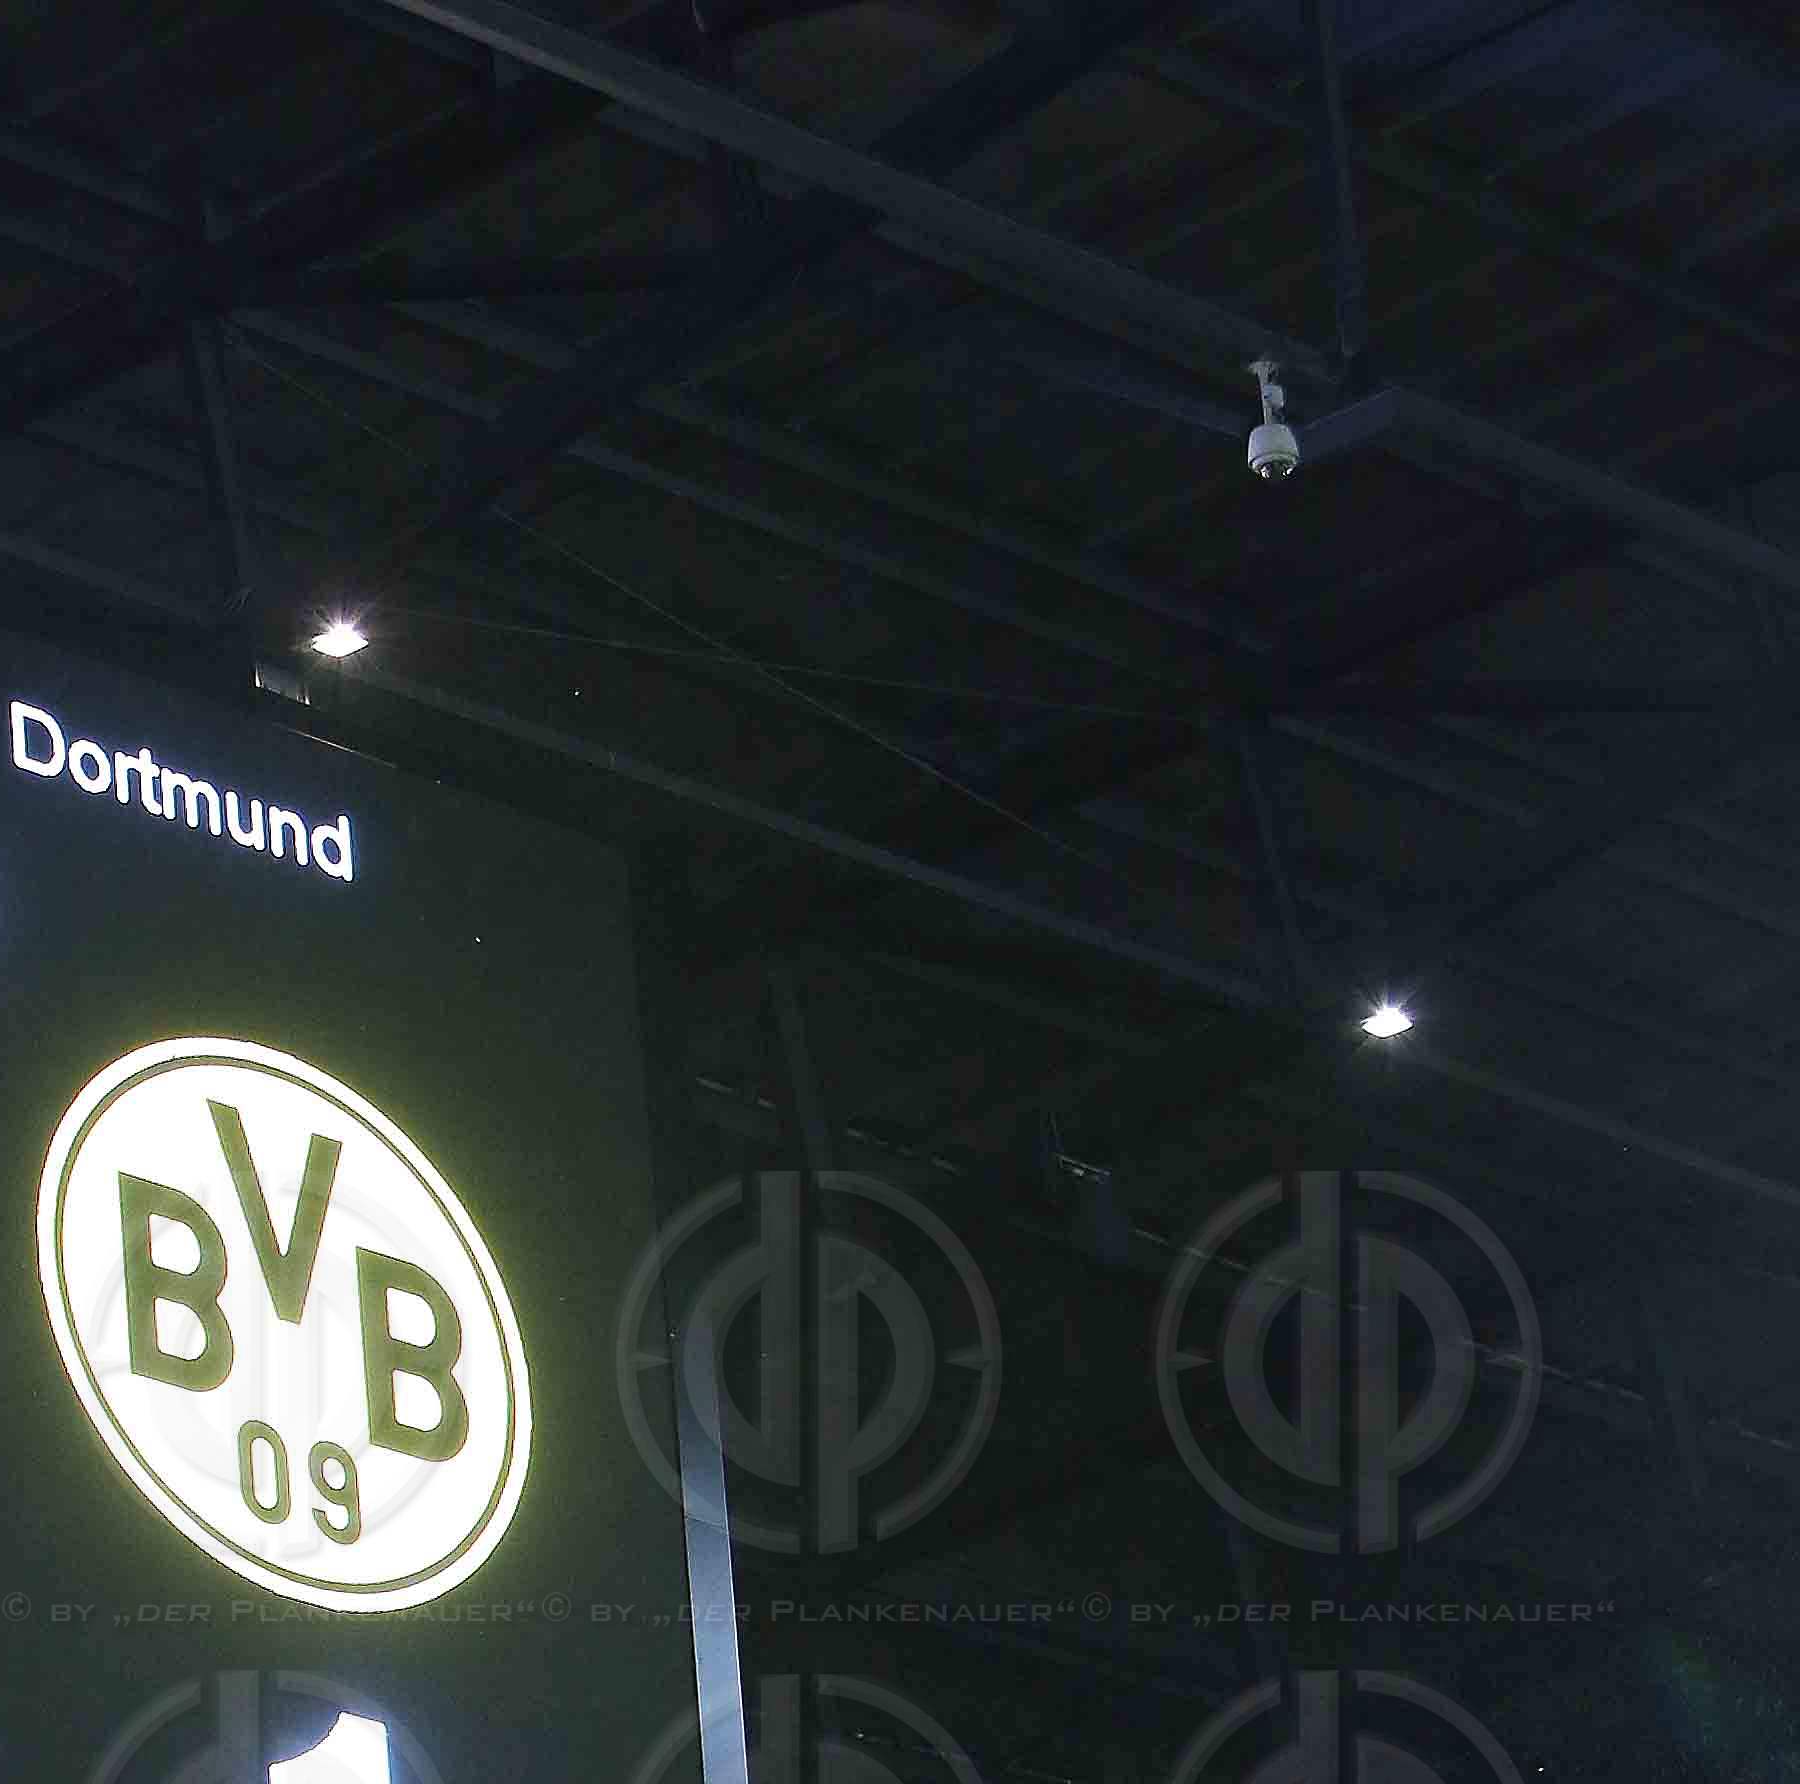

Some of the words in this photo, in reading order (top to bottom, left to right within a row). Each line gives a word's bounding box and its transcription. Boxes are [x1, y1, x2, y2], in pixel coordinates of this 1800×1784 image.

[11, 699, 356, 882] Dortmund
[116, 1098, 470, 1464] BVB
[235, 1418, 363, 1546] 09
